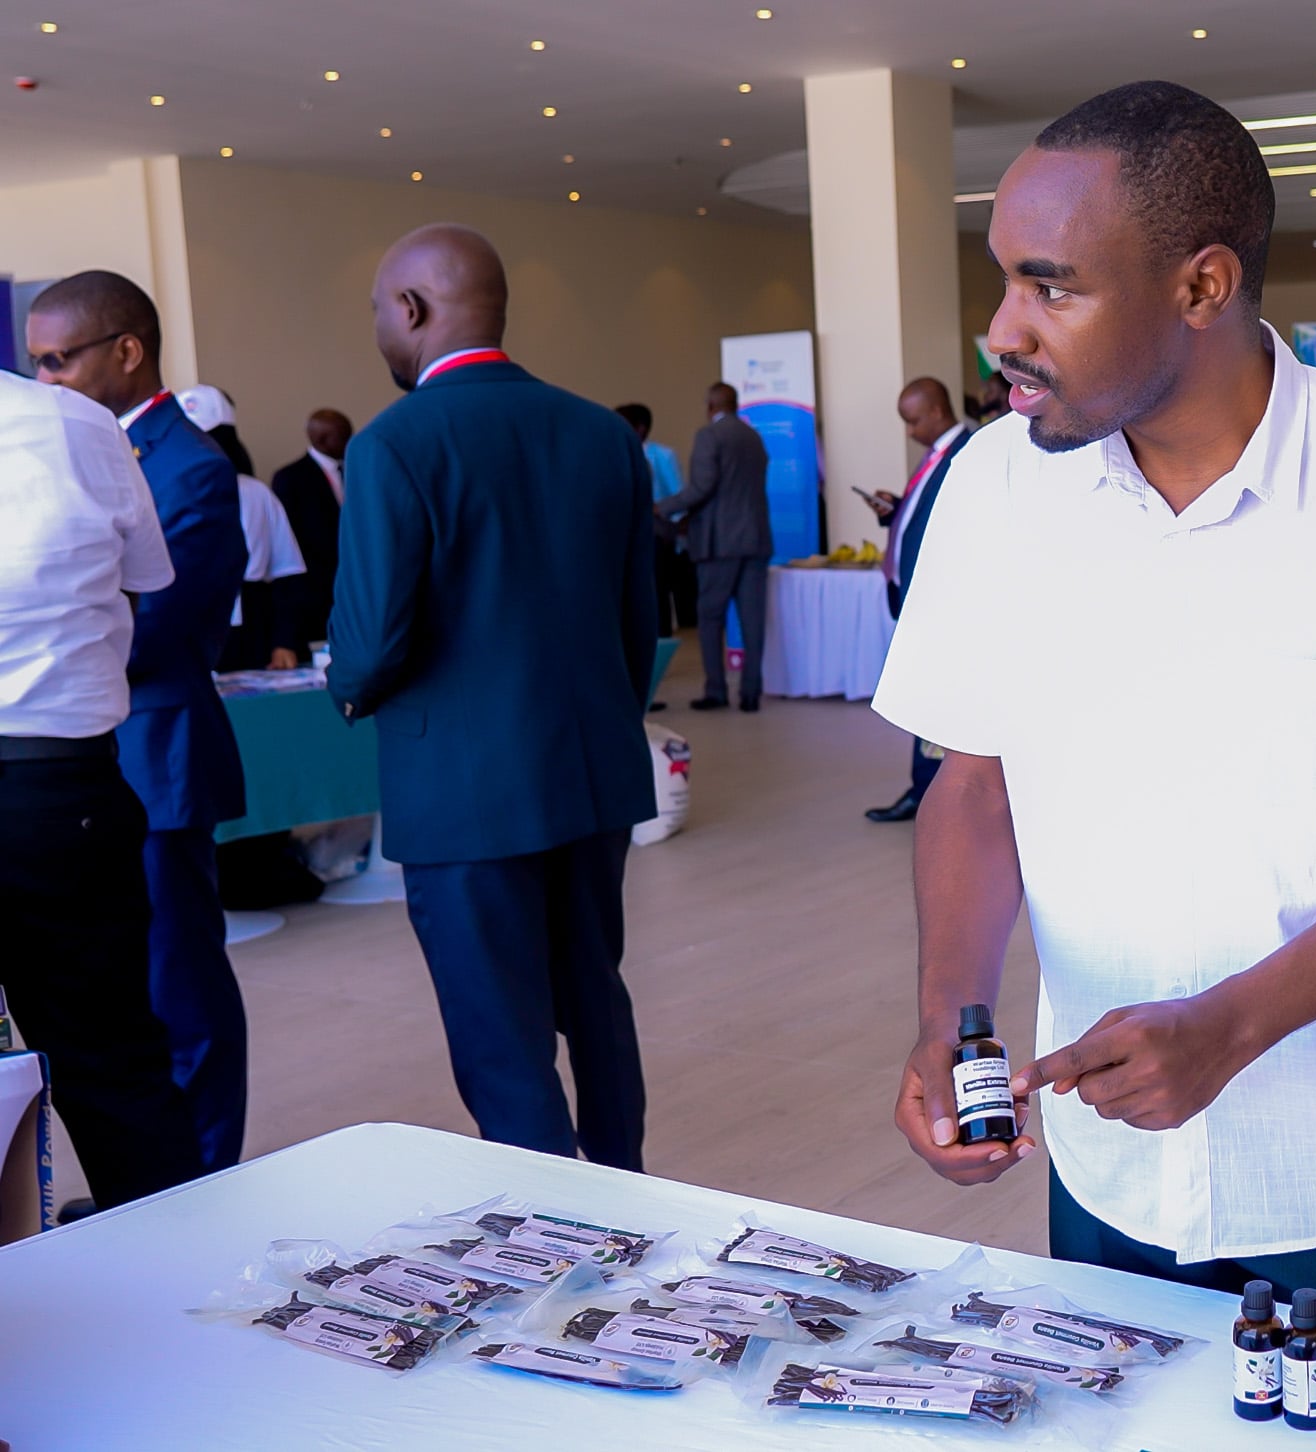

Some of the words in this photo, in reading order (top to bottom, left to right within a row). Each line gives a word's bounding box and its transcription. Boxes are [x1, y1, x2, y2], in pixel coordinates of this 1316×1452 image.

[965, 1080, 986, 1090] Vanilla
[1037, 1326, 1056, 1336] Beans
[1055, 1330, 1080, 1342] Gourmet
[1080, 1338, 1100, 1348] Vanilla
[1016, 1358, 1043, 1367] Gourmet
[1044, 1363, 1065, 1371] Vanilla
